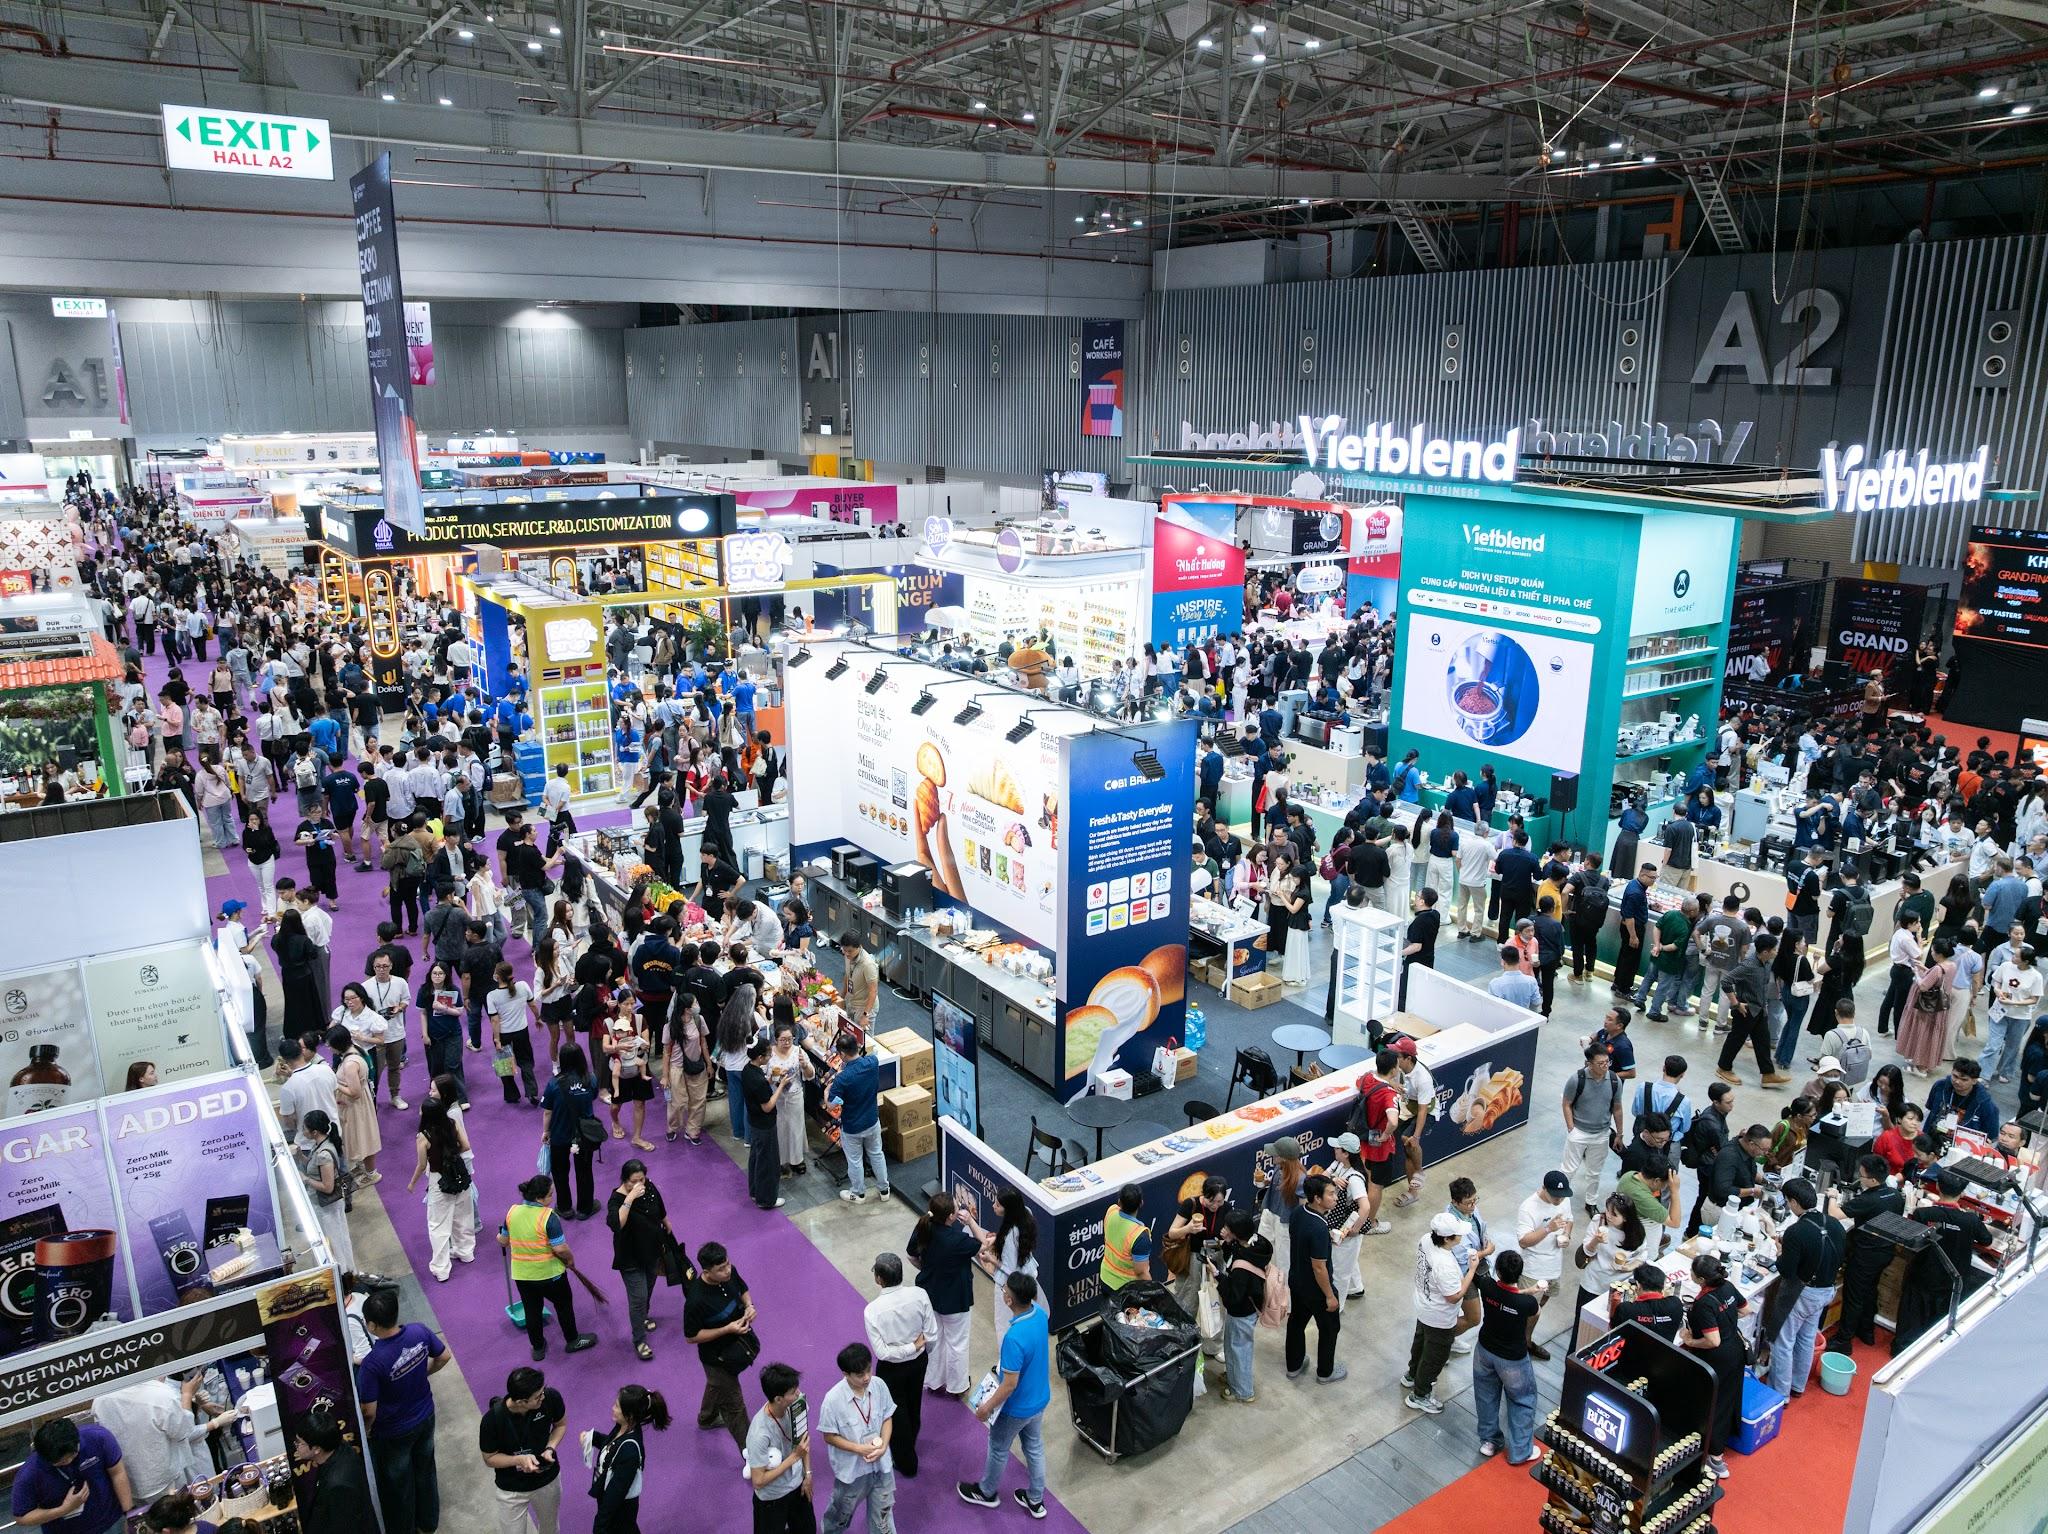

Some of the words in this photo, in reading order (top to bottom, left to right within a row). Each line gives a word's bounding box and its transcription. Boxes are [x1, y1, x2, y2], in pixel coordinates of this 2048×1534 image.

[198, 116, 298, 152] EXIT
[213, 150, 263, 168] HALL
[268, 154, 293, 169] A2
[356, 207, 382, 243] COFFEE
[359, 245, 378, 275] EXPO
[63, 300, 95, 310] EXIT
[405, 321, 424, 335] VENT
[1691, 287, 1840, 386] A2
[1092, 335, 1115, 350] CAFÉ
[807, 331, 839, 379] A1
[42, 357, 109, 402] A1
[1298, 415, 1520, 482] Vietblend
[1328, 477, 1376, 489] SOLUTION
[1380, 481, 1400, 491] FOR
[1402, 483, 1423, 494] F&B
[1427, 485, 1480, 498] BUSINESS
[1821, 444, 1989, 512] Vietblend
[834, 493, 865, 504] BUYER
[829, 503, 865, 514] OUNGE
[1303, 541, 1329, 551] GRAND
[1462, 524, 1545, 552] Vietblend
[728, 538, 774, 561] EASY
[2027, 555, 2048, 568] KH
[1461, 569, 1480, 581] DỊCH
[1481, 572, 1493, 583] VỤ
[1494, 573, 1520, 585] SETUP
[1521, 575, 1545, 588] QUÁN
[1998, 570, 2029, 582] GRAND
[861, 575, 943, 600] PMIUM
[1420, 576, 1442, 588] CUNG
[1443, 577, 1458, 590] CẤP
[1458, 579, 1490, 595] NGUYÊN
[1491, 583, 1510, 598] LIỆU
[1510, 588, 1518, 598] &
[1517, 586, 1542, 602] THIẾT
[1552, 594, 1571, 607] PHA
[1573, 595, 1593, 609] CHẾ
[861, 591, 933, 612] LNGE
[1176, 599, 1223, 615] INSPIRE
[1852, 615, 1875, 624] GRAND
[1876, 618, 1901, 628] COFFEE
[1994, 610, 2022, 619] TASTERS
[19, 637, 49, 645] SOLUTIONS
[1839, 629, 1909, 654] GRAND
[377, 685, 405, 695] Doking
[1040, 731, 1060, 745] CRAC
[857, 752, 875, 770] Mini
[857, 768, 889, 789] croissant
[1104, 777, 1127, 791] COBI
[975, 809, 995, 825] SNACK
[1138, 803, 1173, 818] Everyday
[1156, 872, 1168, 882] GS
[166, 1003, 201, 1018] HoReCa
[25, 1022, 75, 1039] @fuwokcha
[165, 1059, 210, 1076] pullman
[1436, 1088, 1455, 1104] TED
[117, 1088, 249, 1141] ADDED
[3, 1125, 93, 1164] GAR
[201, 1136, 222, 1148] Zero
[222, 1131, 245, 1144] Dark
[201, 1139, 247, 1157] Chocolate
[1296, 1130, 1313, 1150] KED
[125, 1157, 173, 1175] Chocolate
[126, 1154, 148, 1166] Zero
[149, 1148, 170, 1161] Milk
[218, 1152, 236, 1163] 25g
[20, 1175, 45, 1187] Zero
[143, 1170, 161, 1182] 25g
[968, 1163, 999, 1194] FROZEN
[8, 1184, 40, 1199] Cacao
[40, 1179, 61, 1191] Milk
[17, 1190, 57, 1206] Powder
[208, 1231, 241, 1249] ZER
[1068, 1219, 1105, 1247] 한입에
[163, 1240, 199, 1260] ZERO
[1067, 1244, 1105, 1270] One
[1067, 1273, 1101, 1298] MINI
[46, 1286, 93, 1305] ZERO
[1067, 1285, 1103, 1308] CROI
[1637, 1315, 1655, 1324] UCC
[1, 1352, 95, 1390] VIETNAM
[99, 1331, 165, 1361] CACAO
[0, 1387, 41, 1411] OCK
[51, 1355, 142, 1393] COMPANY
[1586, 1407, 1619, 1439] BLACK
[2010, 1446, 2048, 1486] INTERNATION
[1595, 1493, 1622, 1518] BLACK
